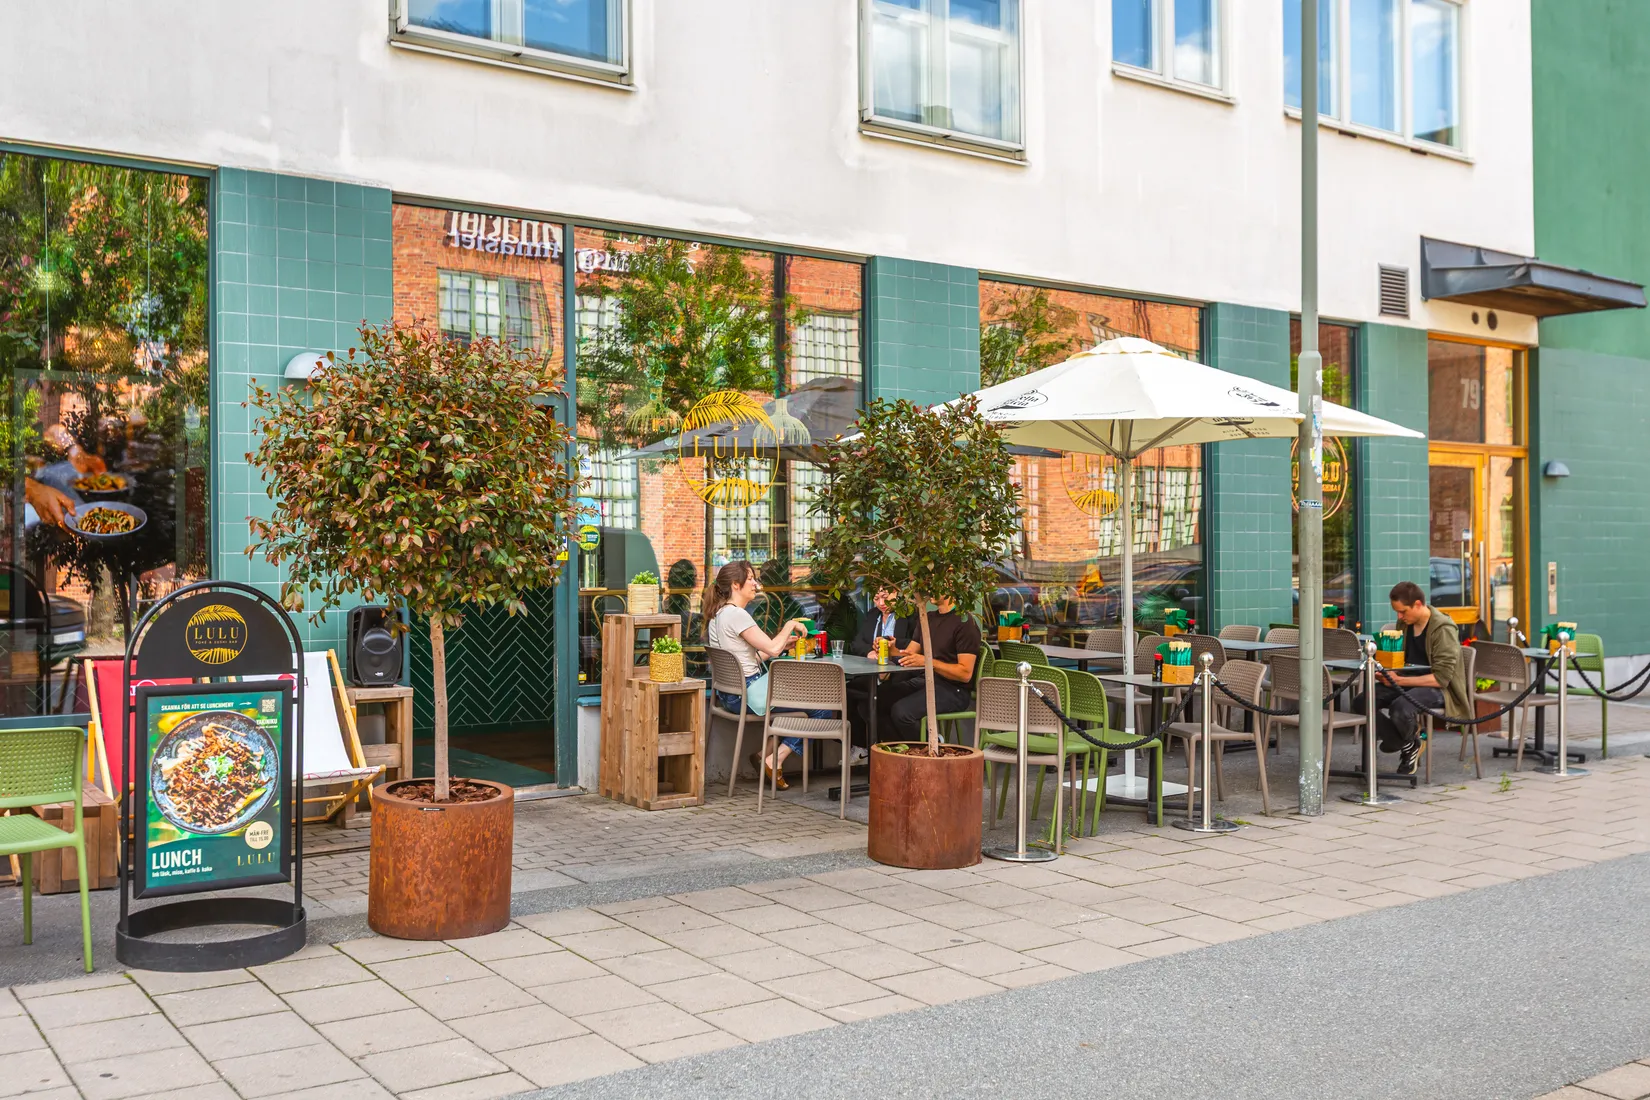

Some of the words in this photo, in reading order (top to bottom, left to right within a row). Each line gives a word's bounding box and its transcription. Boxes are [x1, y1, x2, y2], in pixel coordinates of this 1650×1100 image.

[1460, 378, 1480, 410] 79
[693, 435, 765, 460] LULU
[194, 627, 239, 640] LULU
[151, 848, 202, 870] LUNCH
[237, 852, 276, 867] LULU
